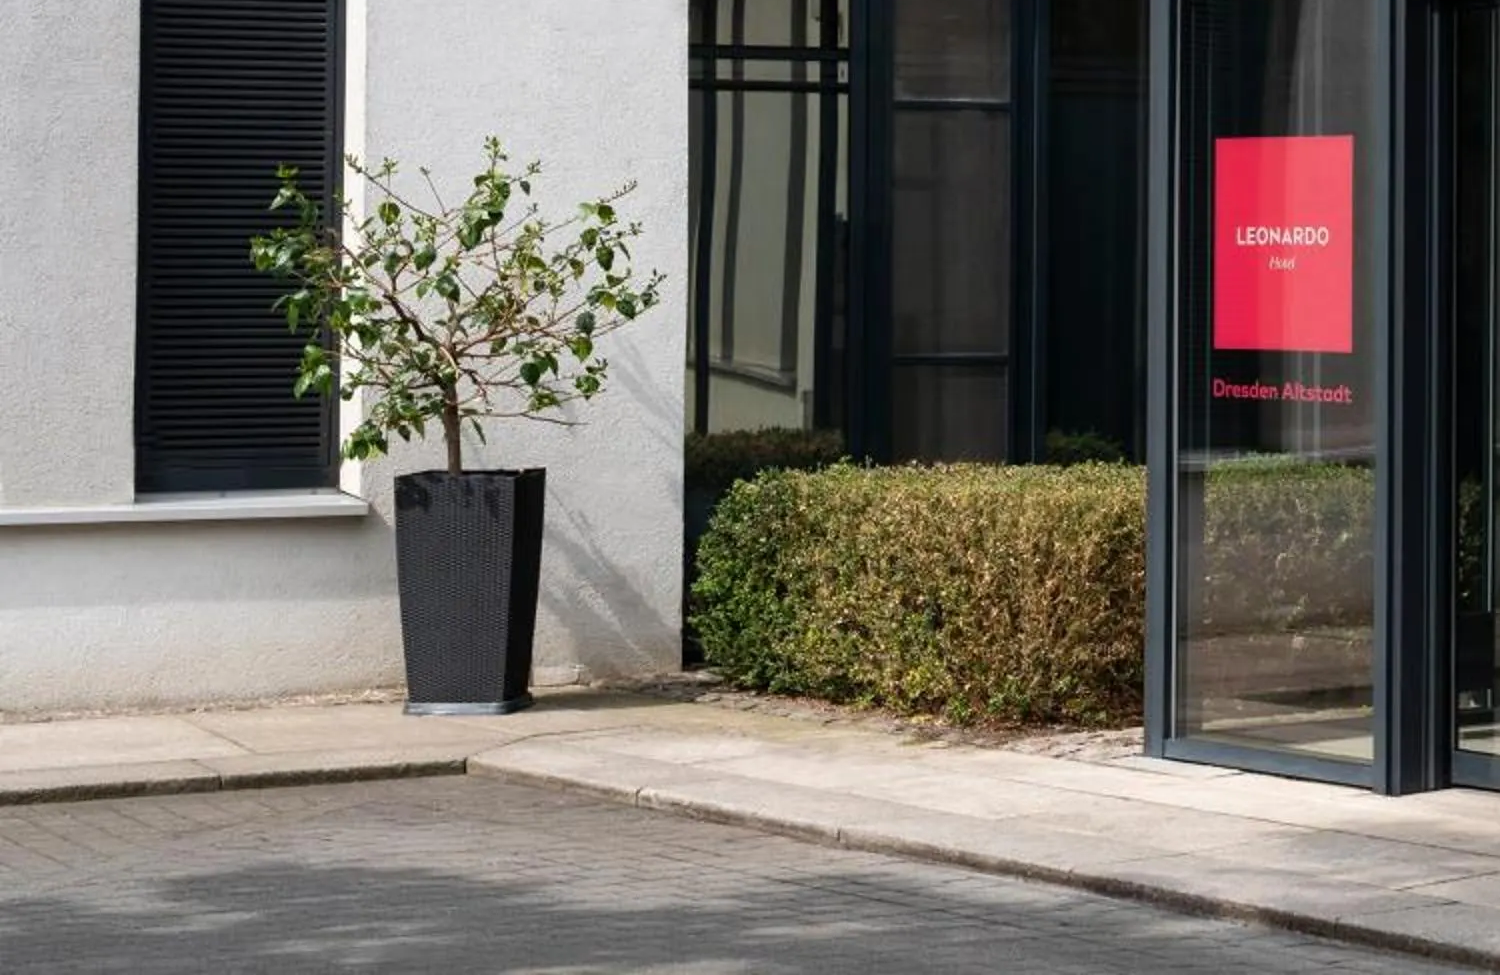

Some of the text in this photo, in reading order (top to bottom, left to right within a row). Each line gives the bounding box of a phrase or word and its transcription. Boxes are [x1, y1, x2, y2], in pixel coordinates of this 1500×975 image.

[1236, 225, 1330, 247] LEONARDO
[1212, 378, 1353, 403] Dresden Altstadt
